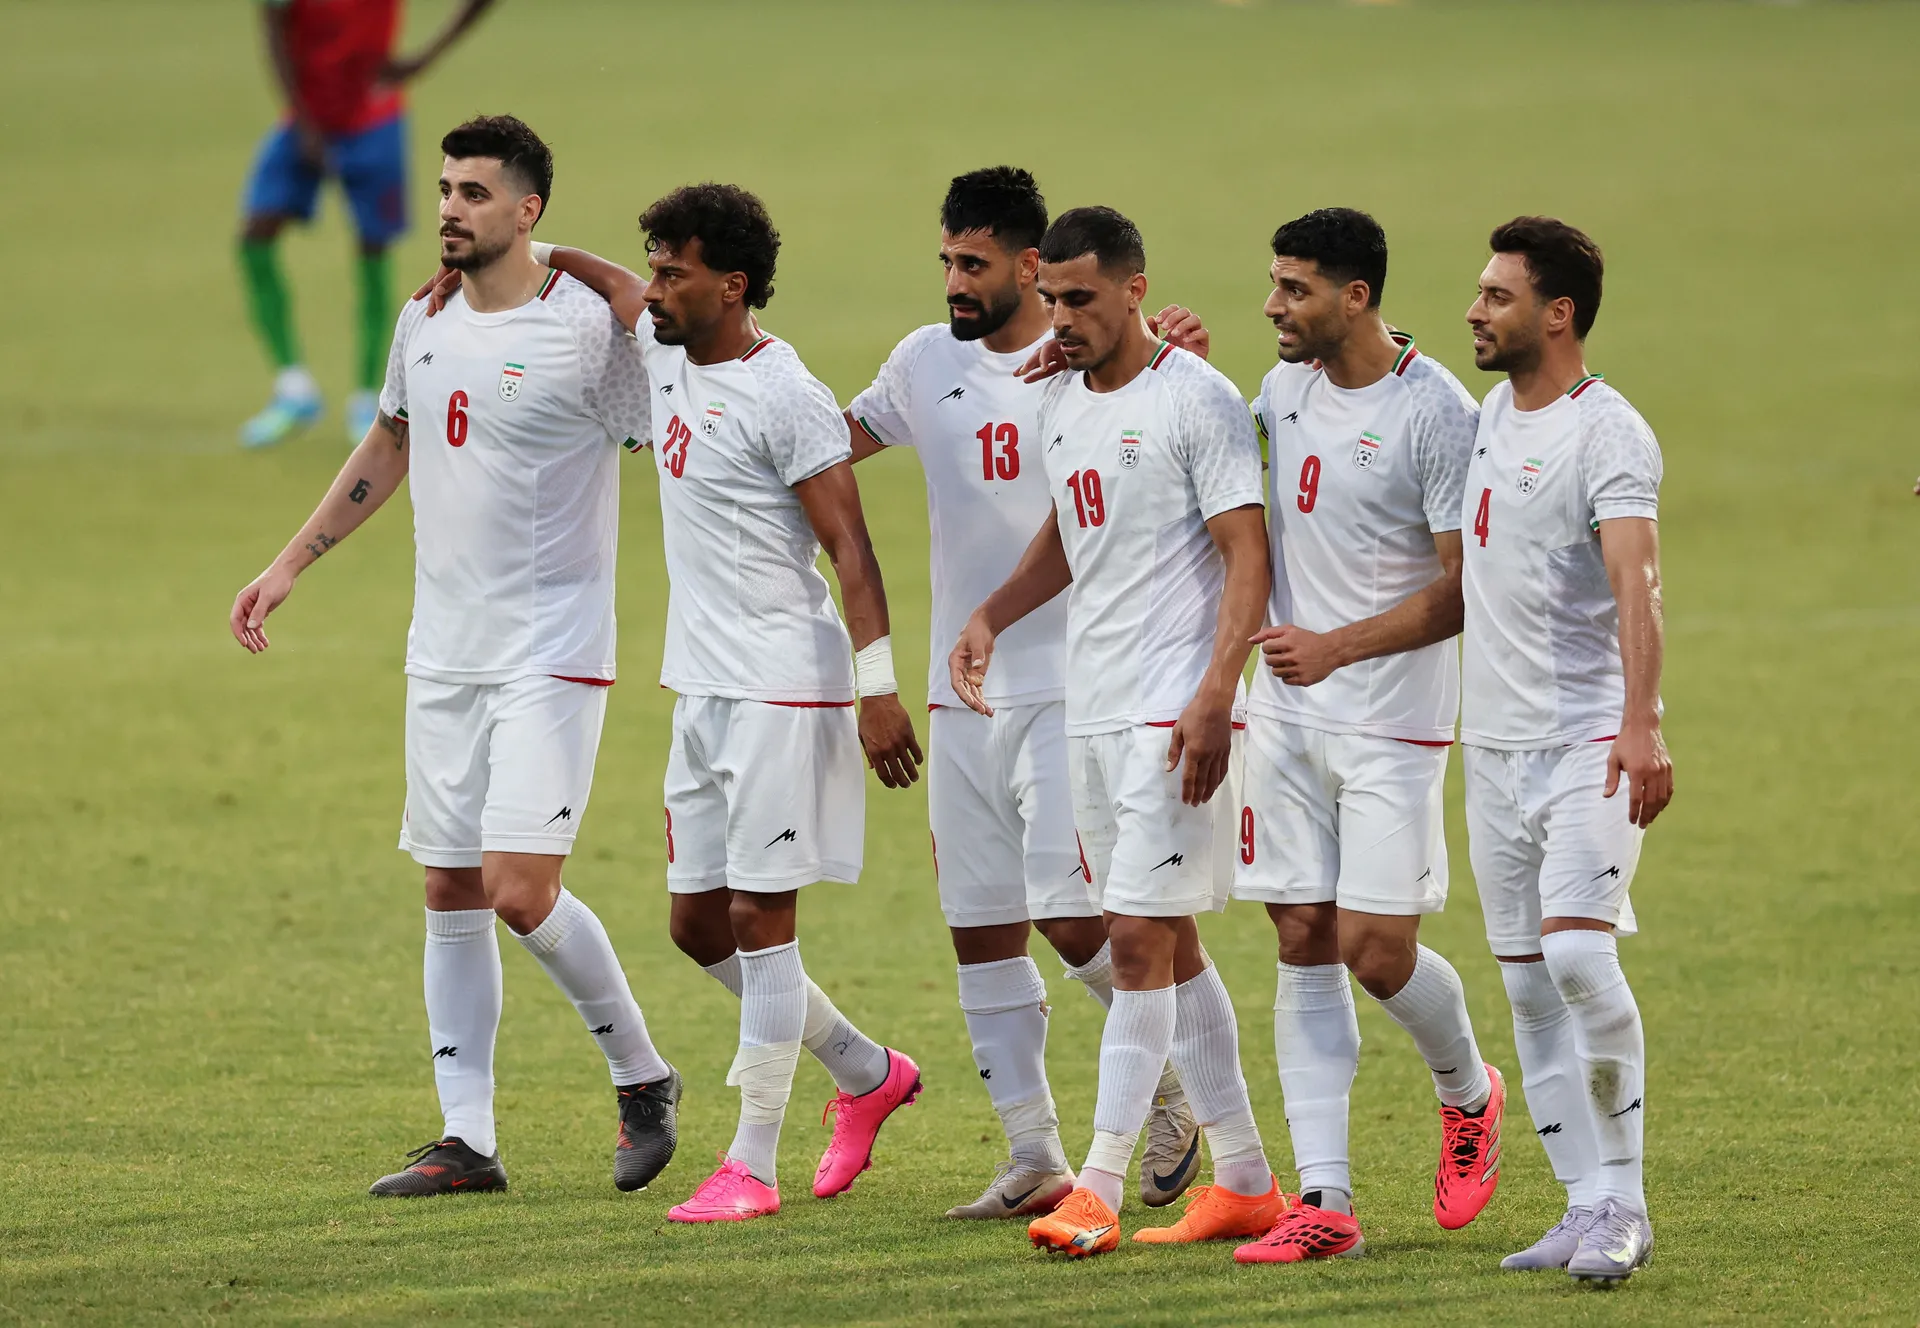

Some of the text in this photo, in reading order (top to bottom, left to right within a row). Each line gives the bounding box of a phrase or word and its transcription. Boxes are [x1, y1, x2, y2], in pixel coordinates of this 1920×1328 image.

[446, 389, 469, 448] 6
[663, 415, 692, 479] 23
[976, 421, 1020, 481] 13
[348, 477, 372, 505] 6
[1066, 468, 1106, 529] 19
[1297, 455, 1321, 514] 9
[1473, 487, 1492, 548] 4
[1240, 805, 1256, 865] 9
